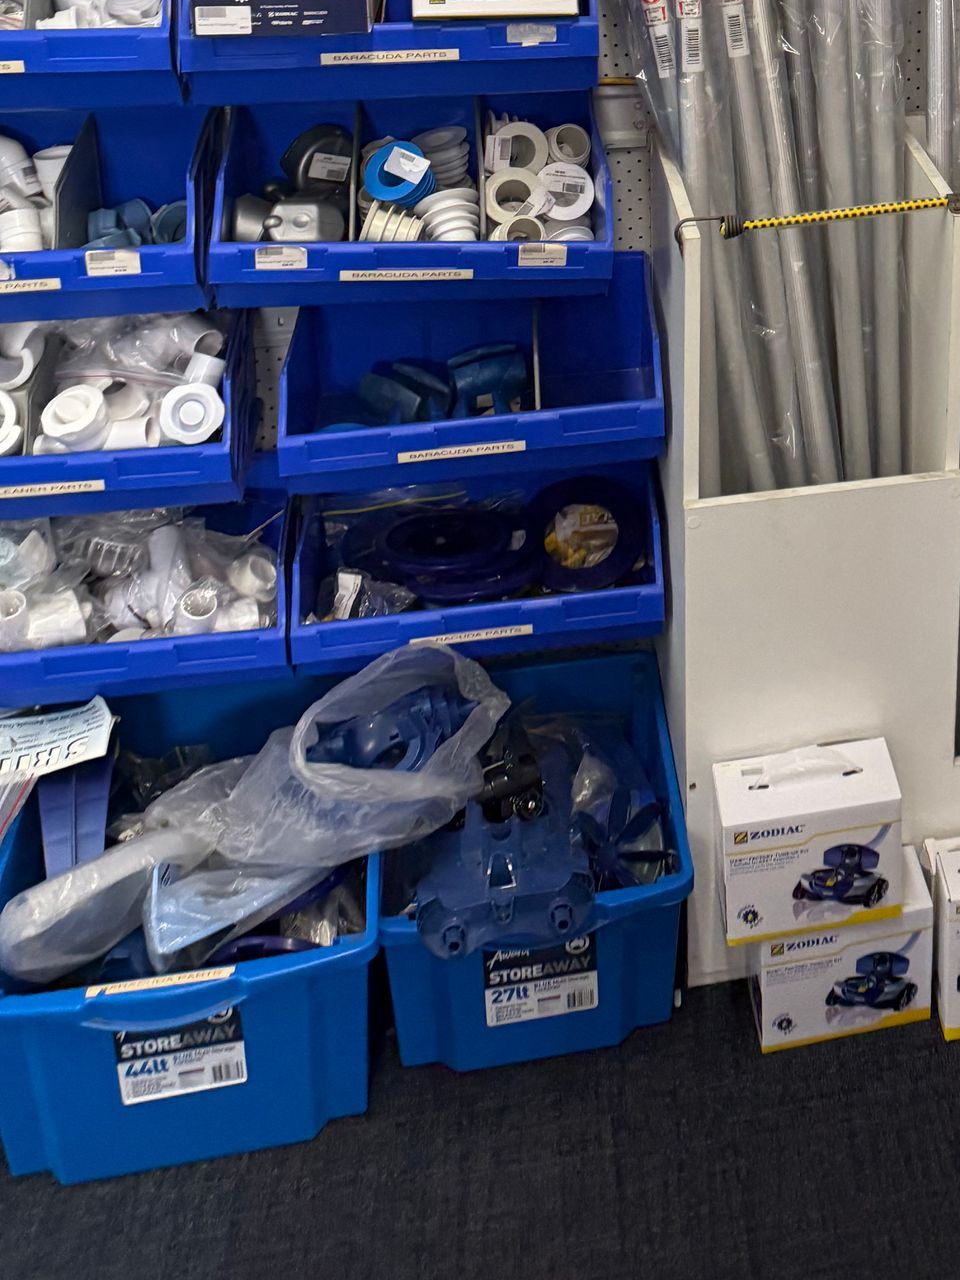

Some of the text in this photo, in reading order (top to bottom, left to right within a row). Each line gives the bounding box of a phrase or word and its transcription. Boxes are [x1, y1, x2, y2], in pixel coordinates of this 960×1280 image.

[333, 51, 447, 61] BARACUDA PARTS
[351, 270, 462, 280] BARACUDA PARTS
[409, 444, 515, 460] BARACUDA PARTS
[485, 627, 522, 637] PARTS
[750, 824, 804, 840] ZODIAC
[786, 934, 838, 951] ZODIAC
[489, 955, 591, 986] STOREAWAY
[491, 985, 530, 1005] 27lt
[120, 1023, 237, 1059] STOREAWAY
[125, 1058, 170, 1079] 44lt
